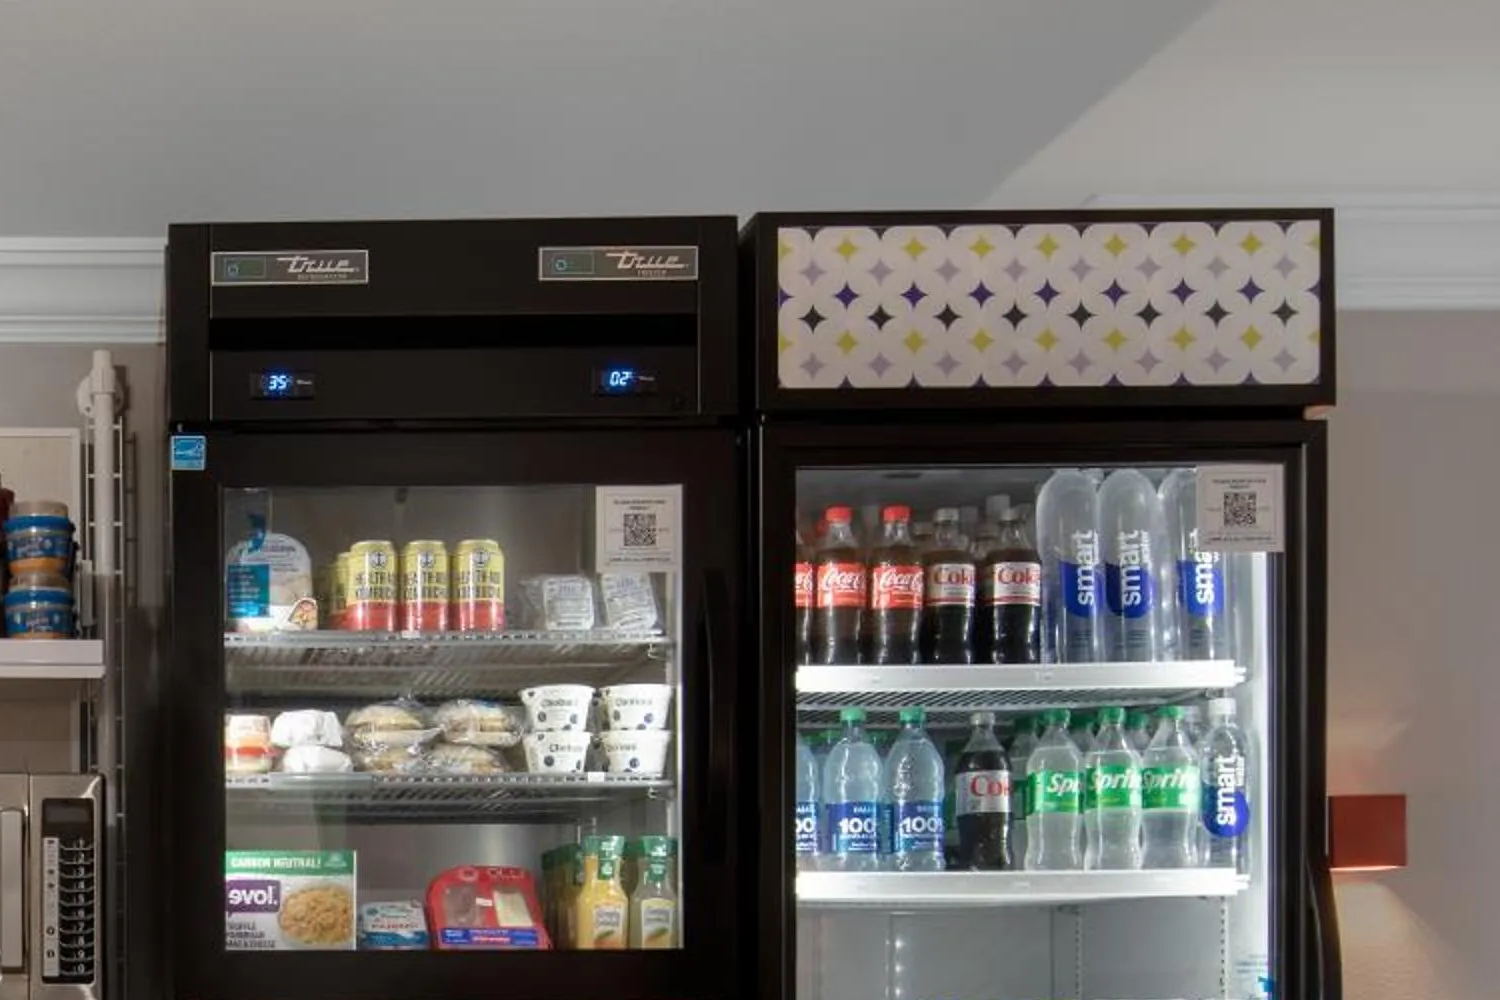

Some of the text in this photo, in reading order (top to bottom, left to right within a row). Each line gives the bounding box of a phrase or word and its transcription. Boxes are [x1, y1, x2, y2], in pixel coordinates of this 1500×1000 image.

[1077, 529, 1095, 606] smart
[1119, 529, 1142, 606] smart
[1217, 753, 1236, 827] smart
